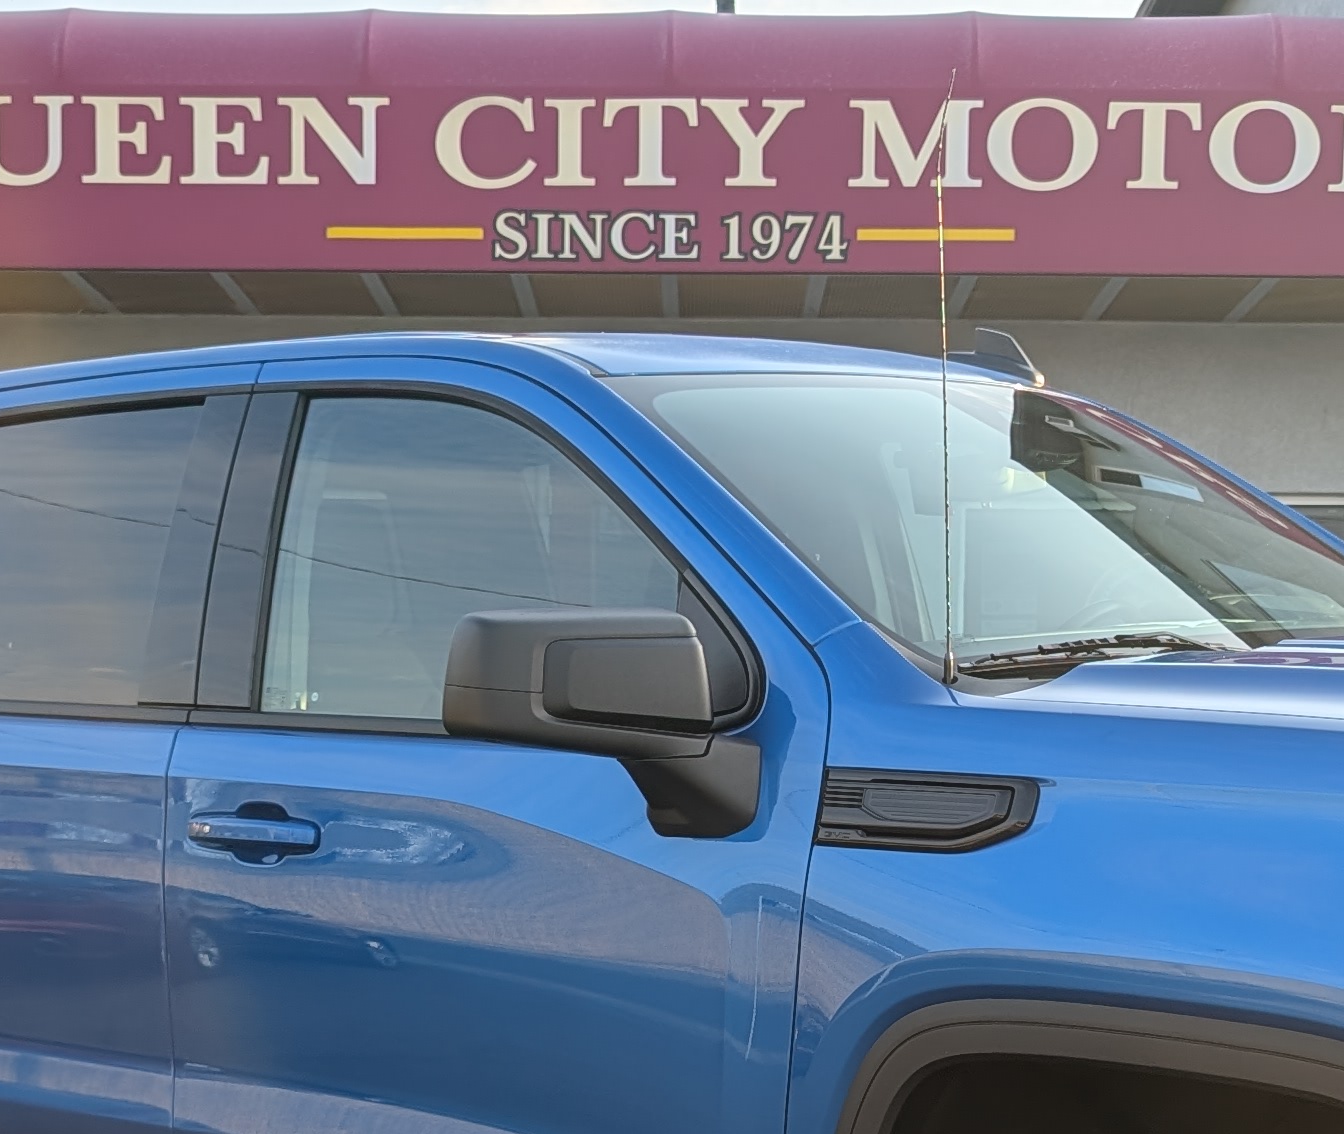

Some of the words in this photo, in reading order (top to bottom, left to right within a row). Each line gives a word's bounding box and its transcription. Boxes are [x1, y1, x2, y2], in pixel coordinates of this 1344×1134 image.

[434, 96, 805, 190] CITY
[492, 210, 701, 262] SINCE
[720, 213, 850, 263] 1974
